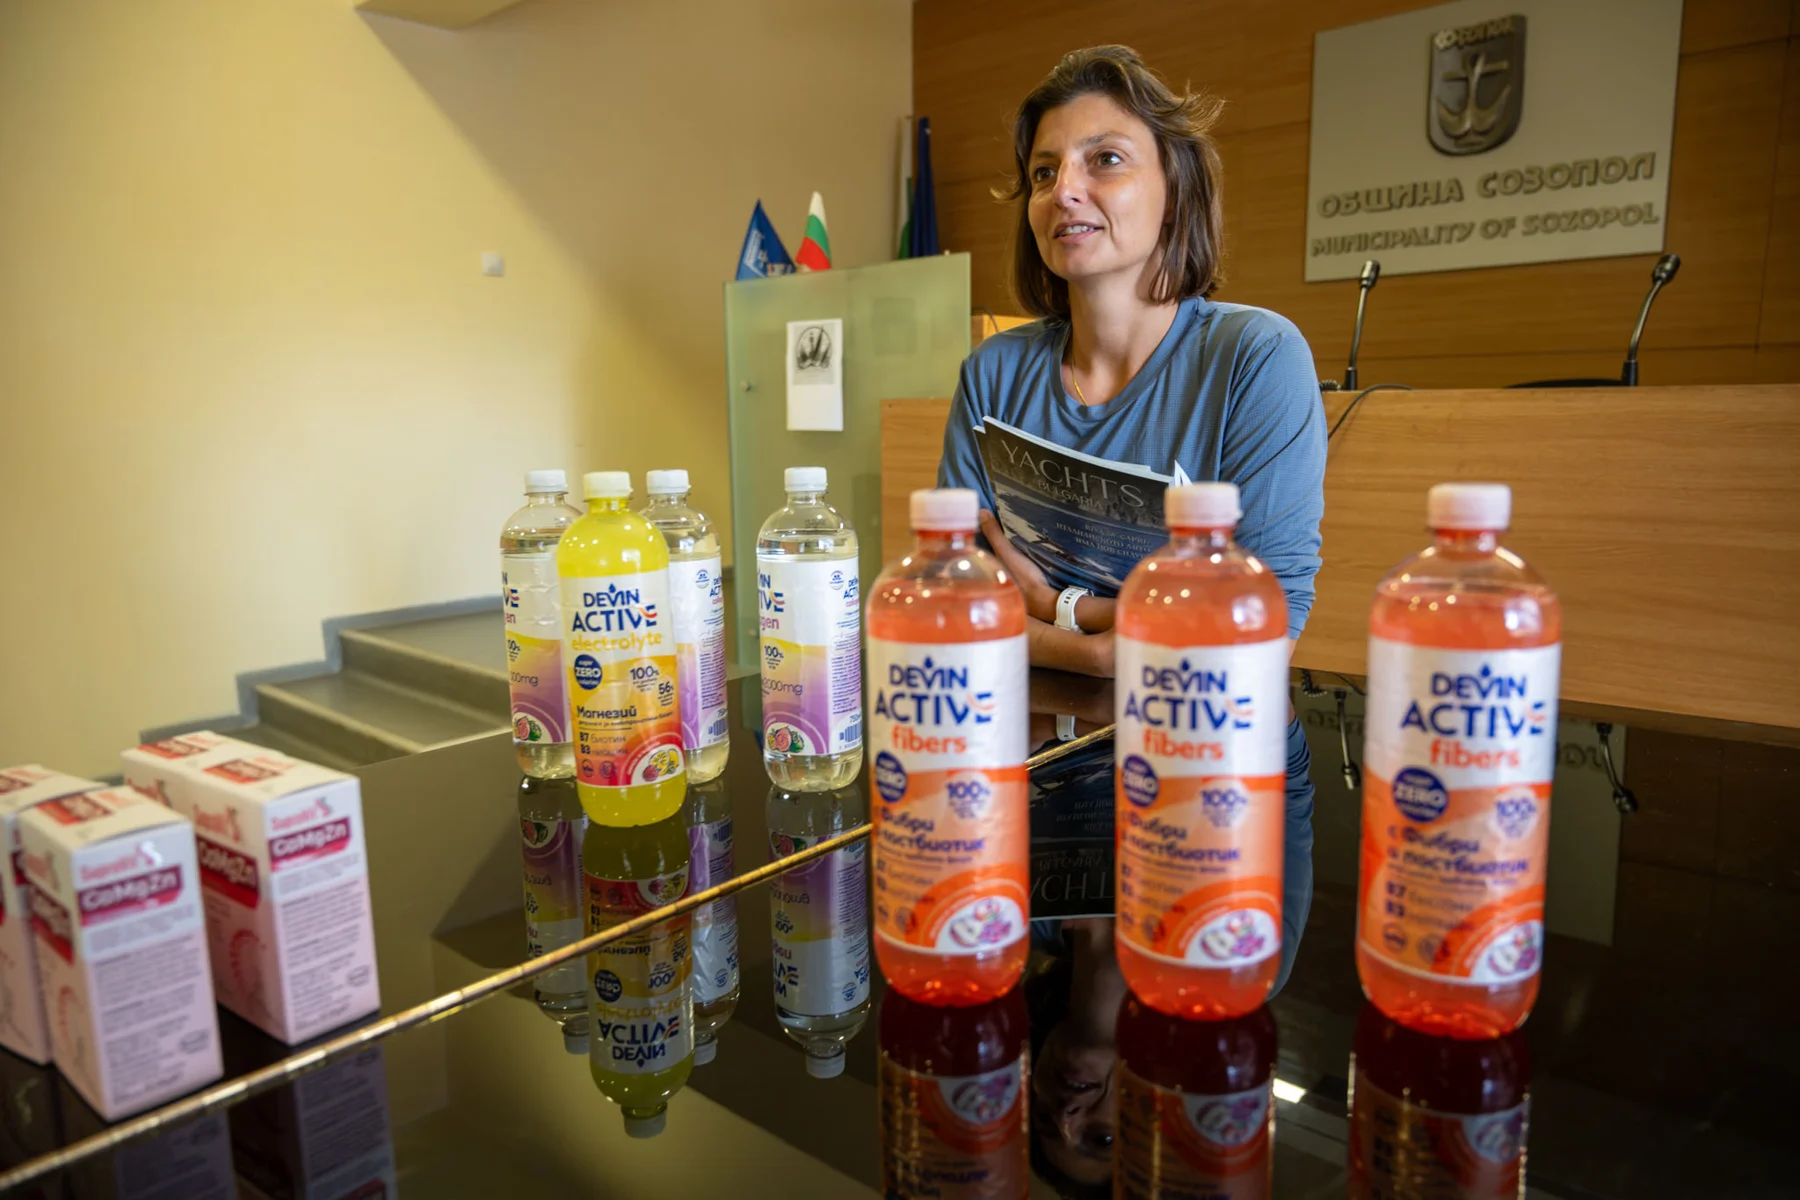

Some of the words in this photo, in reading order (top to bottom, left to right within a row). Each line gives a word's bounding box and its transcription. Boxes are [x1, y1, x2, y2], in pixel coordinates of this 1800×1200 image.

[1317, 178, 1464, 219] ОБЩИНА
[1476, 151, 1657, 199] СОЗОПОЛ
[1311, 222, 1475, 257] MUNICIPALITY
[1480, 216, 1517, 240] OF
[1521, 202, 1659, 237] SOZOPOL
[1001, 439, 1144, 508] YACHTS
[583, 588, 640, 608] DEVIN
[572, 604, 658, 632] ACTIVE
[572, 631, 663, 652] electrolyte
[575, 667, 602, 678] ZERO
[889, 663, 968, 689] DEVIN
[1142, 665, 1227, 692] DEVIN
[1432, 672, 1526, 699] DEVIN
[577, 704, 637, 719] Магнезий
[875, 689, 995, 725] ACTIVE
[1124, 690, 1254, 730] ACTIVE
[1400, 700, 1546, 738] ACTIVE
[892, 724, 968, 754] fibers
[1144, 728, 1224, 760] fibers
[1430, 738, 1520, 769] fibers
[270, 823, 347, 858] CaMgZn
[81, 871, 178, 912] CaMgZn
